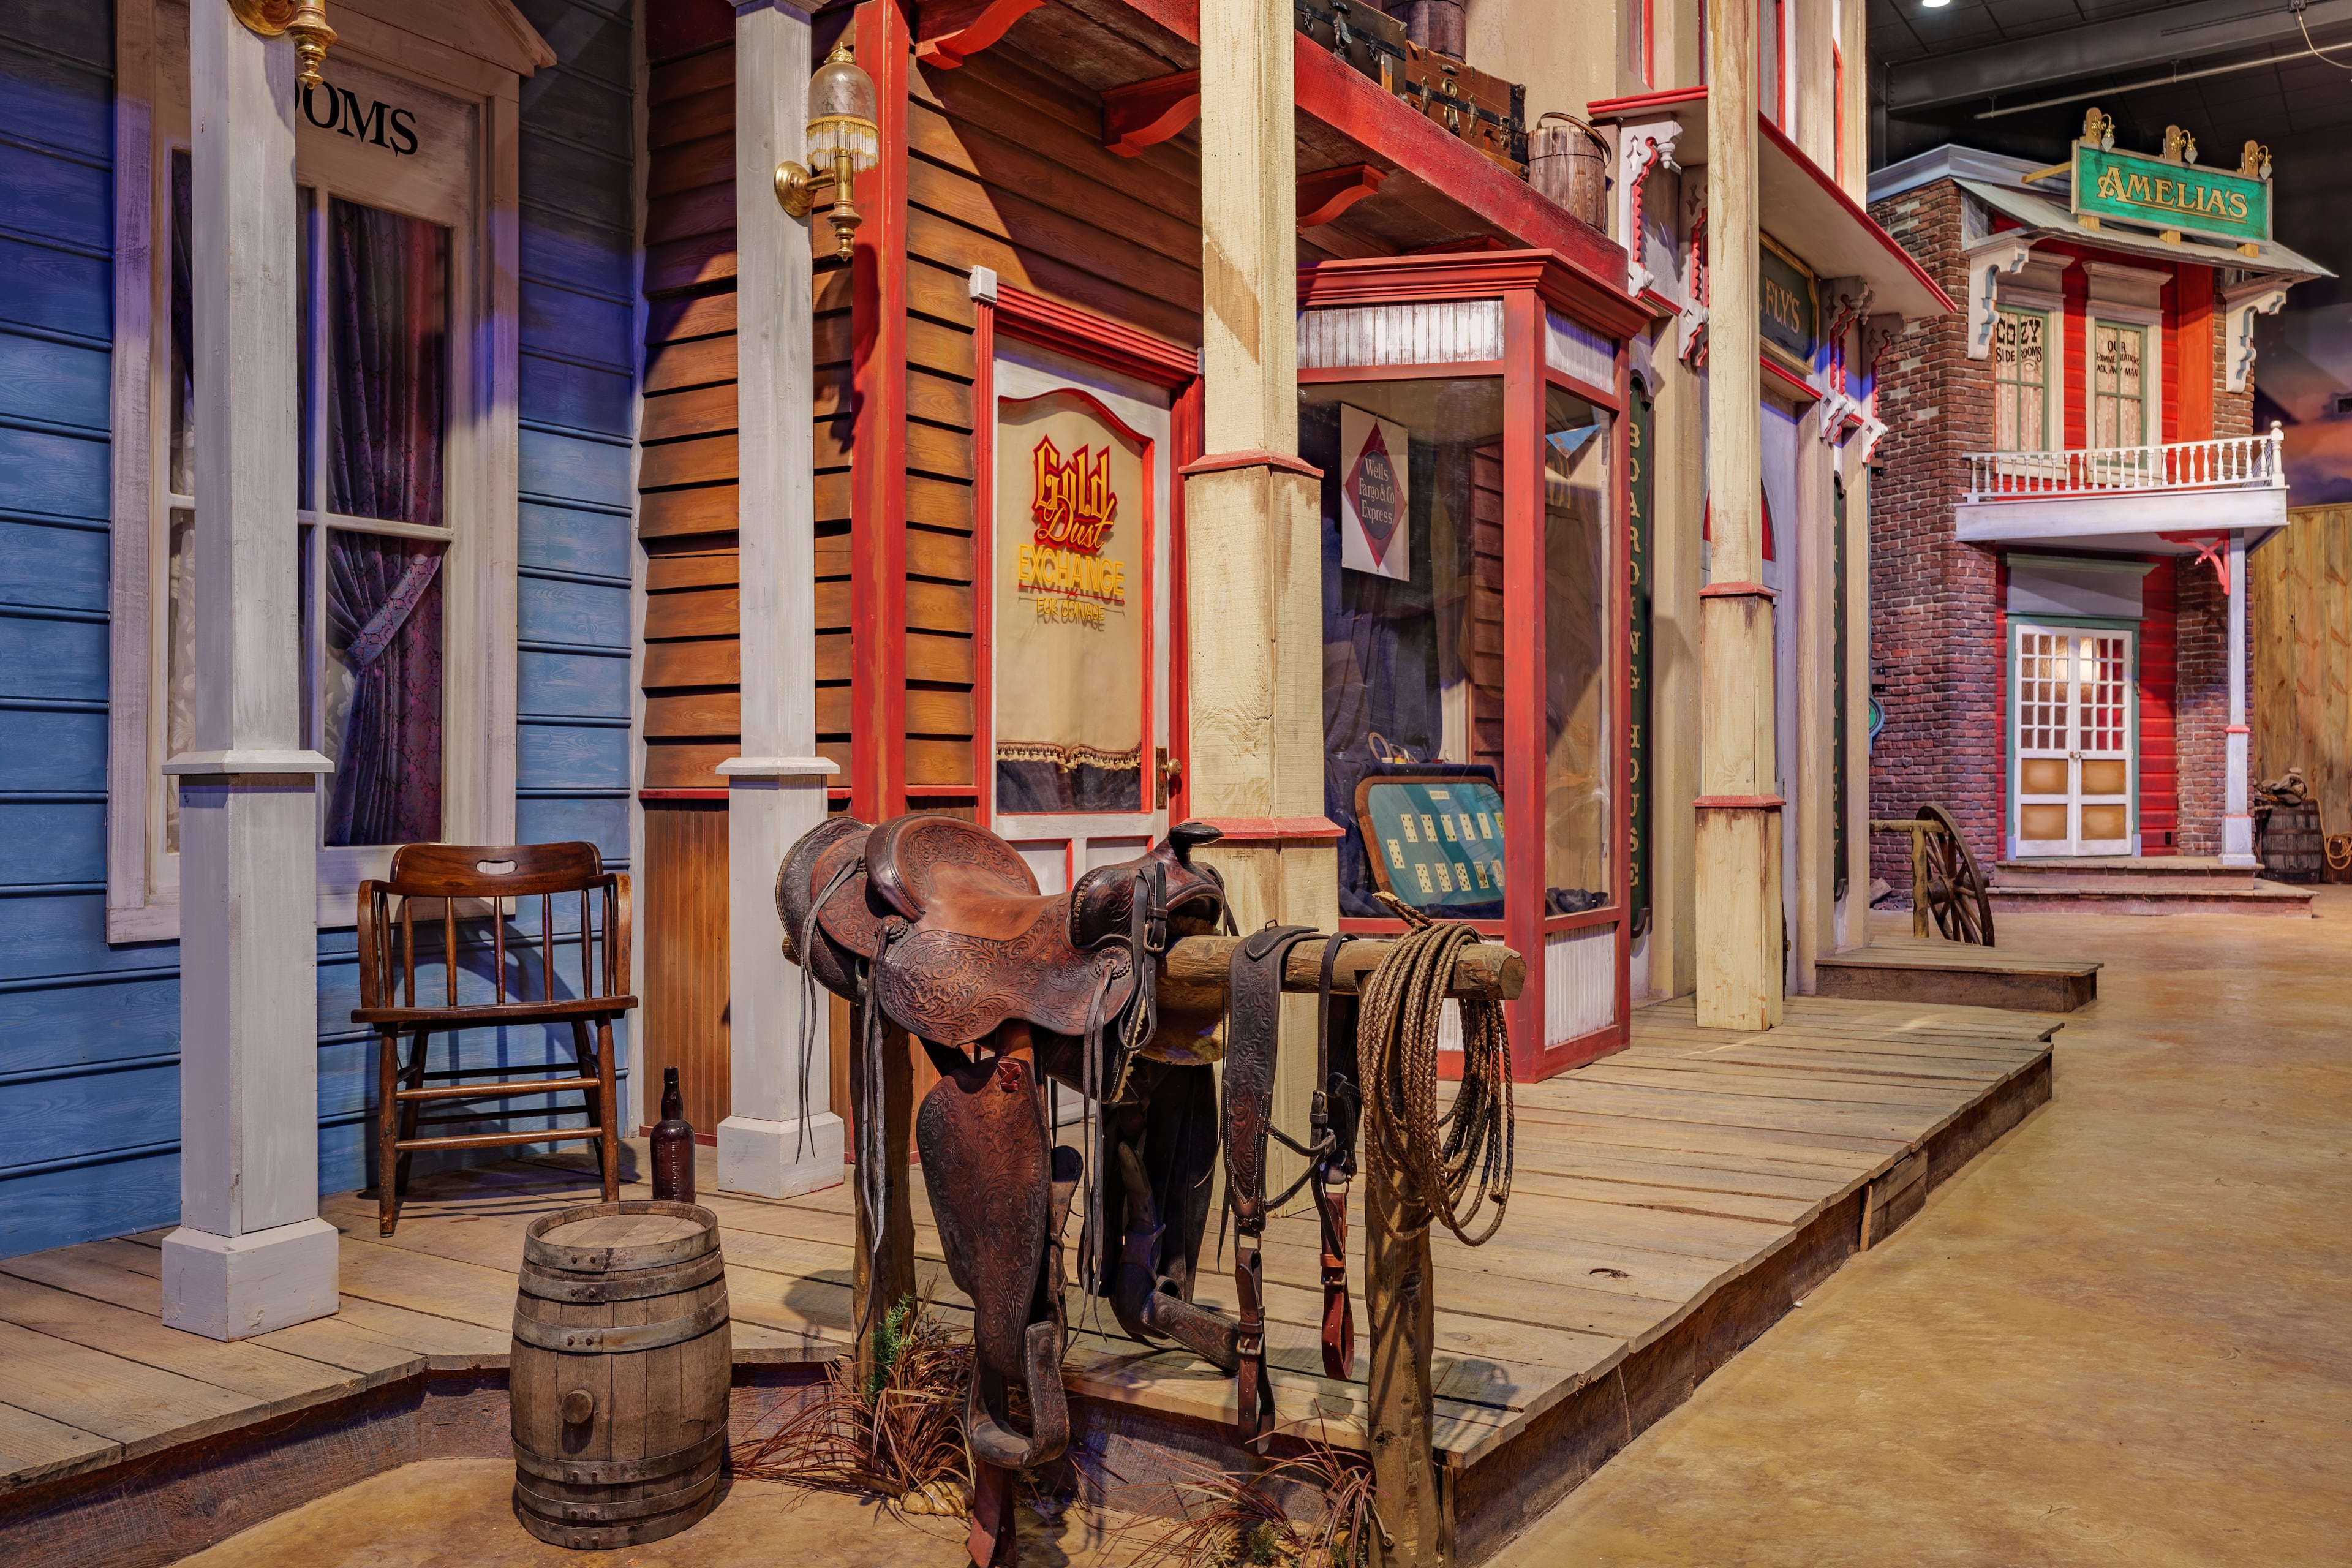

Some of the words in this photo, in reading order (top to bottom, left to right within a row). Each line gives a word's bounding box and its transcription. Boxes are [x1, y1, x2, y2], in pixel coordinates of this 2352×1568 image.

[295, 78, 418, 157] OMS
[2097, 165, 2248, 219] AMELIA'S
[1765, 277, 1800, 334] FLY'S
[1996, 317, 2041, 346] COZY
[1996, 347, 2015, 363] SIDE
[2125, 368, 2138, 377] MAN
[1033, 437, 1109, 519] Gold
[1365, 458, 1389, 481] Wells
[1359, 477, 1379, 502] Fargo
[1380, 484, 1385, 502] &
[1386, 486, 1395, 504] Co
[1037, 495, 1115, 549] Dust
[1362, 499, 1393, 524] Express
[1019, 543, 1125, 596] EXCHANGE
[1036, 597, 1059, 616] FOR
[1061, 599, 1106, 621] COINAGE
